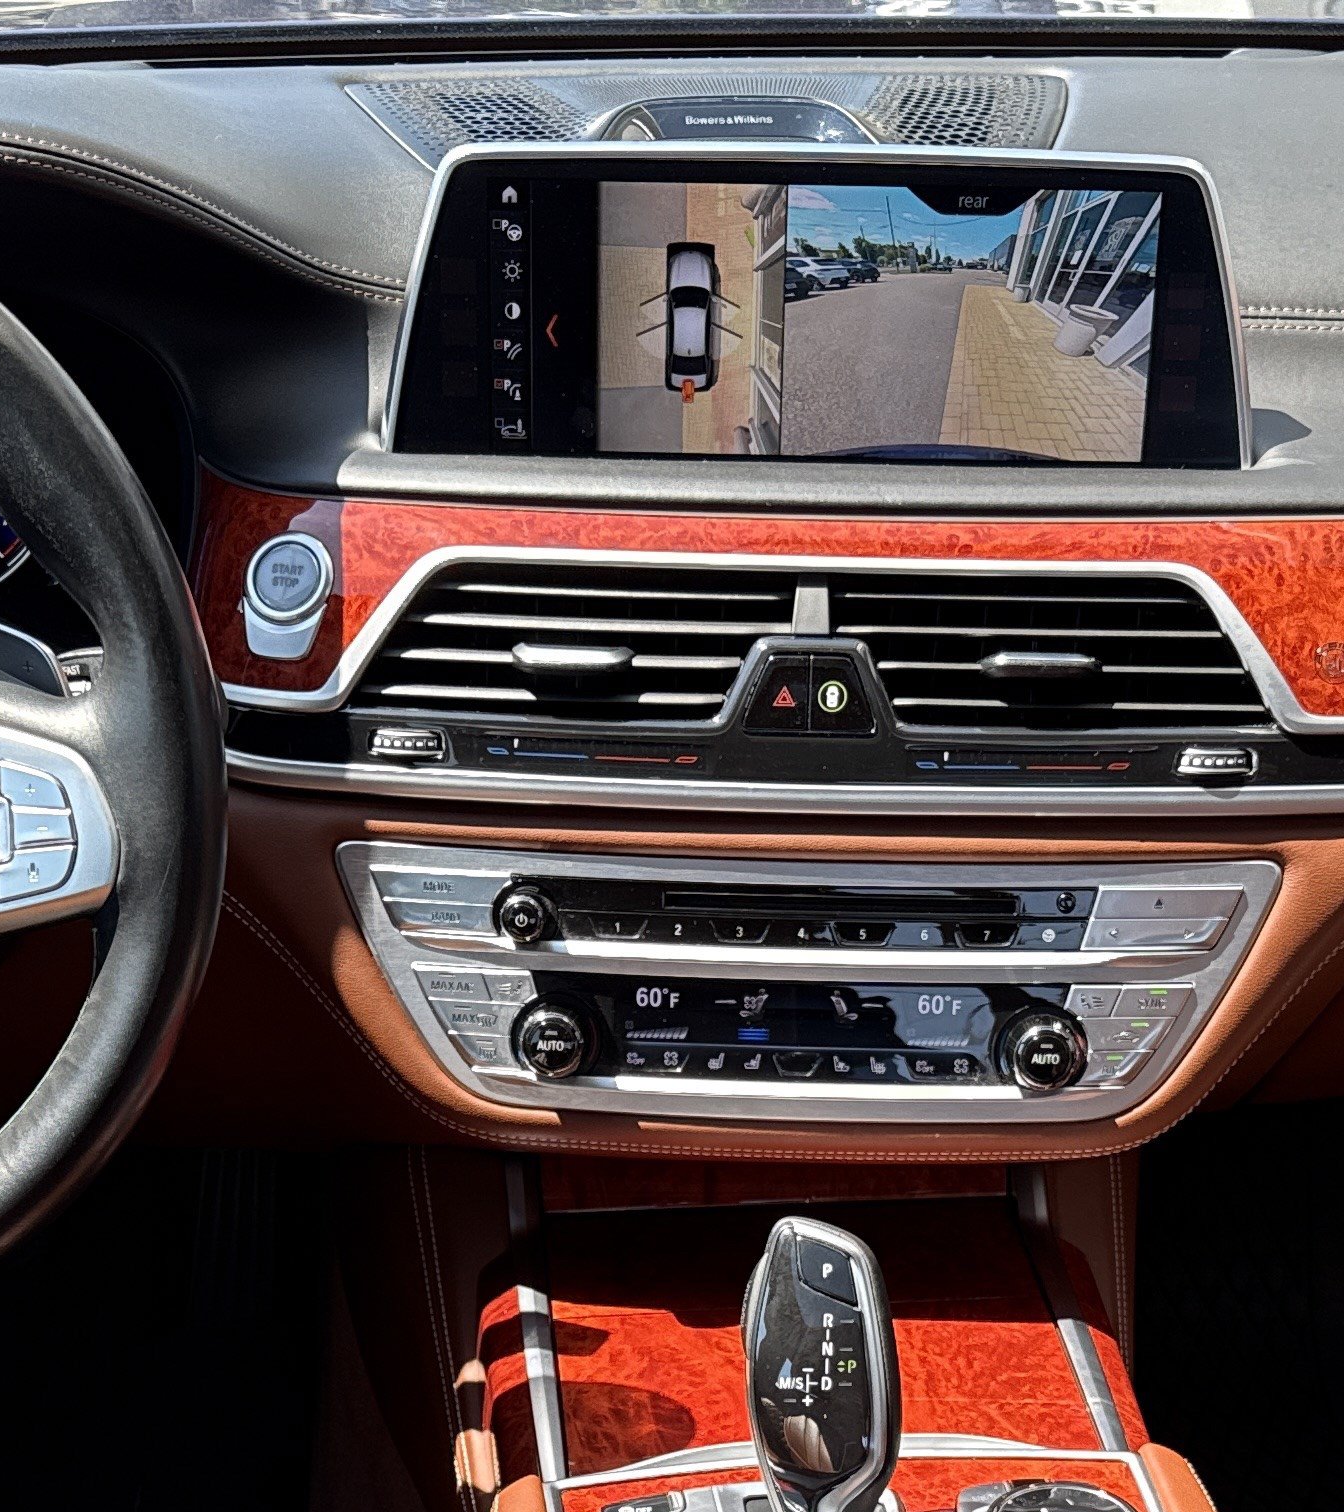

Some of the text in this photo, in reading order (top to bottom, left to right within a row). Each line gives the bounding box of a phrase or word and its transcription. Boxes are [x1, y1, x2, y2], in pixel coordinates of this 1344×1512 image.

[685, 115, 725, 125] Bowers
[734, 115, 774, 125] Wilkins
[958, 194, 989, 209] rear
[271, 563, 304, 576] START
[272, 576, 299, 588] STOP
[614, 922, 621, 933] 1
[674, 923, 682, 936] 2
[735, 926, 744, 938] 3
[797, 927, 806, 939] 4
[859, 928, 867, 940] 5
[920, 929, 929, 941] 6
[982, 930, 991, 942] 7
[430, 980, 455, 992] MAX
[635, 987, 680, 1009] 60°F
[917, 994, 962, 1015] 60°F
[451, 1012, 476, 1024] MAX
[536, 1040, 565, 1052] AUTO
[1031, 1053, 1060, 1066] AUTO
[822, 1263, 834, 1279] P
[822, 1313, 834, 1328] R
[821, 1341, 834, 1356] N
[847, 1360, 857, 1373] P
[778, 1376, 804, 1390] M/S
[821, 1376, 832, 1391] D
